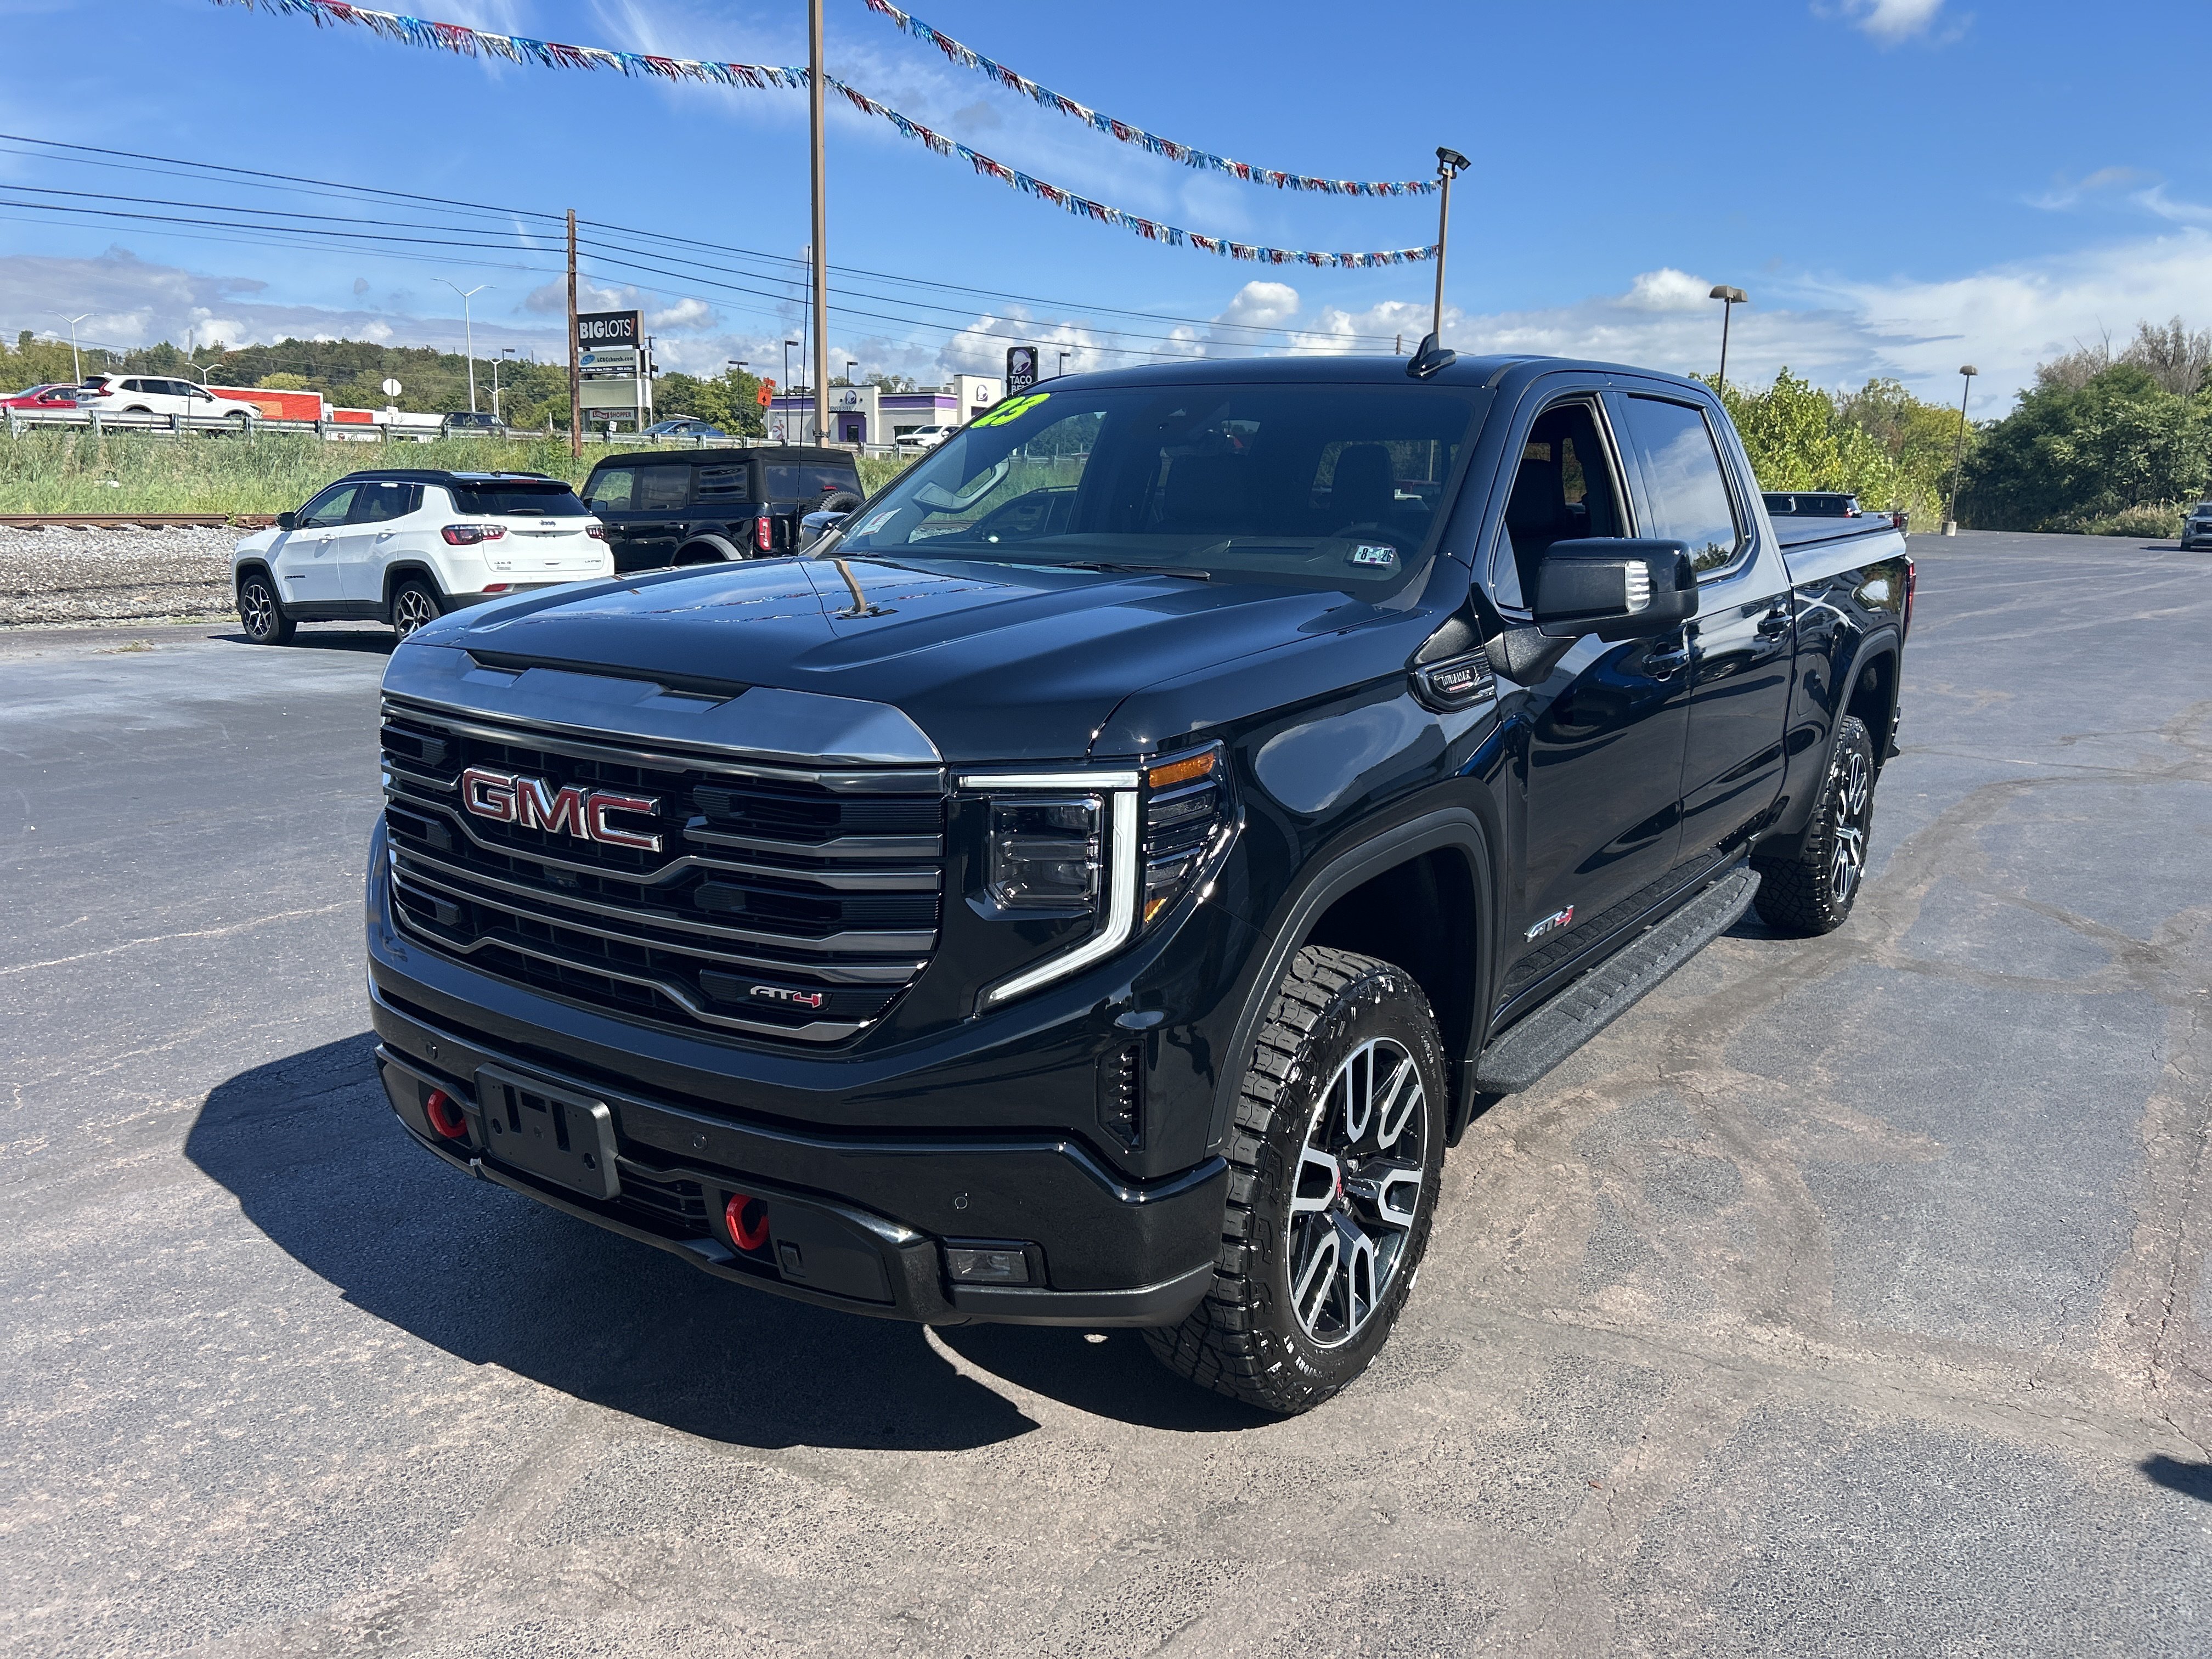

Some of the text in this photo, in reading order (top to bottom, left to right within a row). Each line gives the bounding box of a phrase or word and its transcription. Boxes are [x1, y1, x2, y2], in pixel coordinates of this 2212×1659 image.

[1009, 375, 1032, 385] TACO
[970, 393, 1051, 428] 23
[1360, 548, 1393, 562] 8 26
[462, 765, 663, 853] GMC
[1523, 904, 1575, 943] AT4
[750, 985, 823, 1008] AT4
